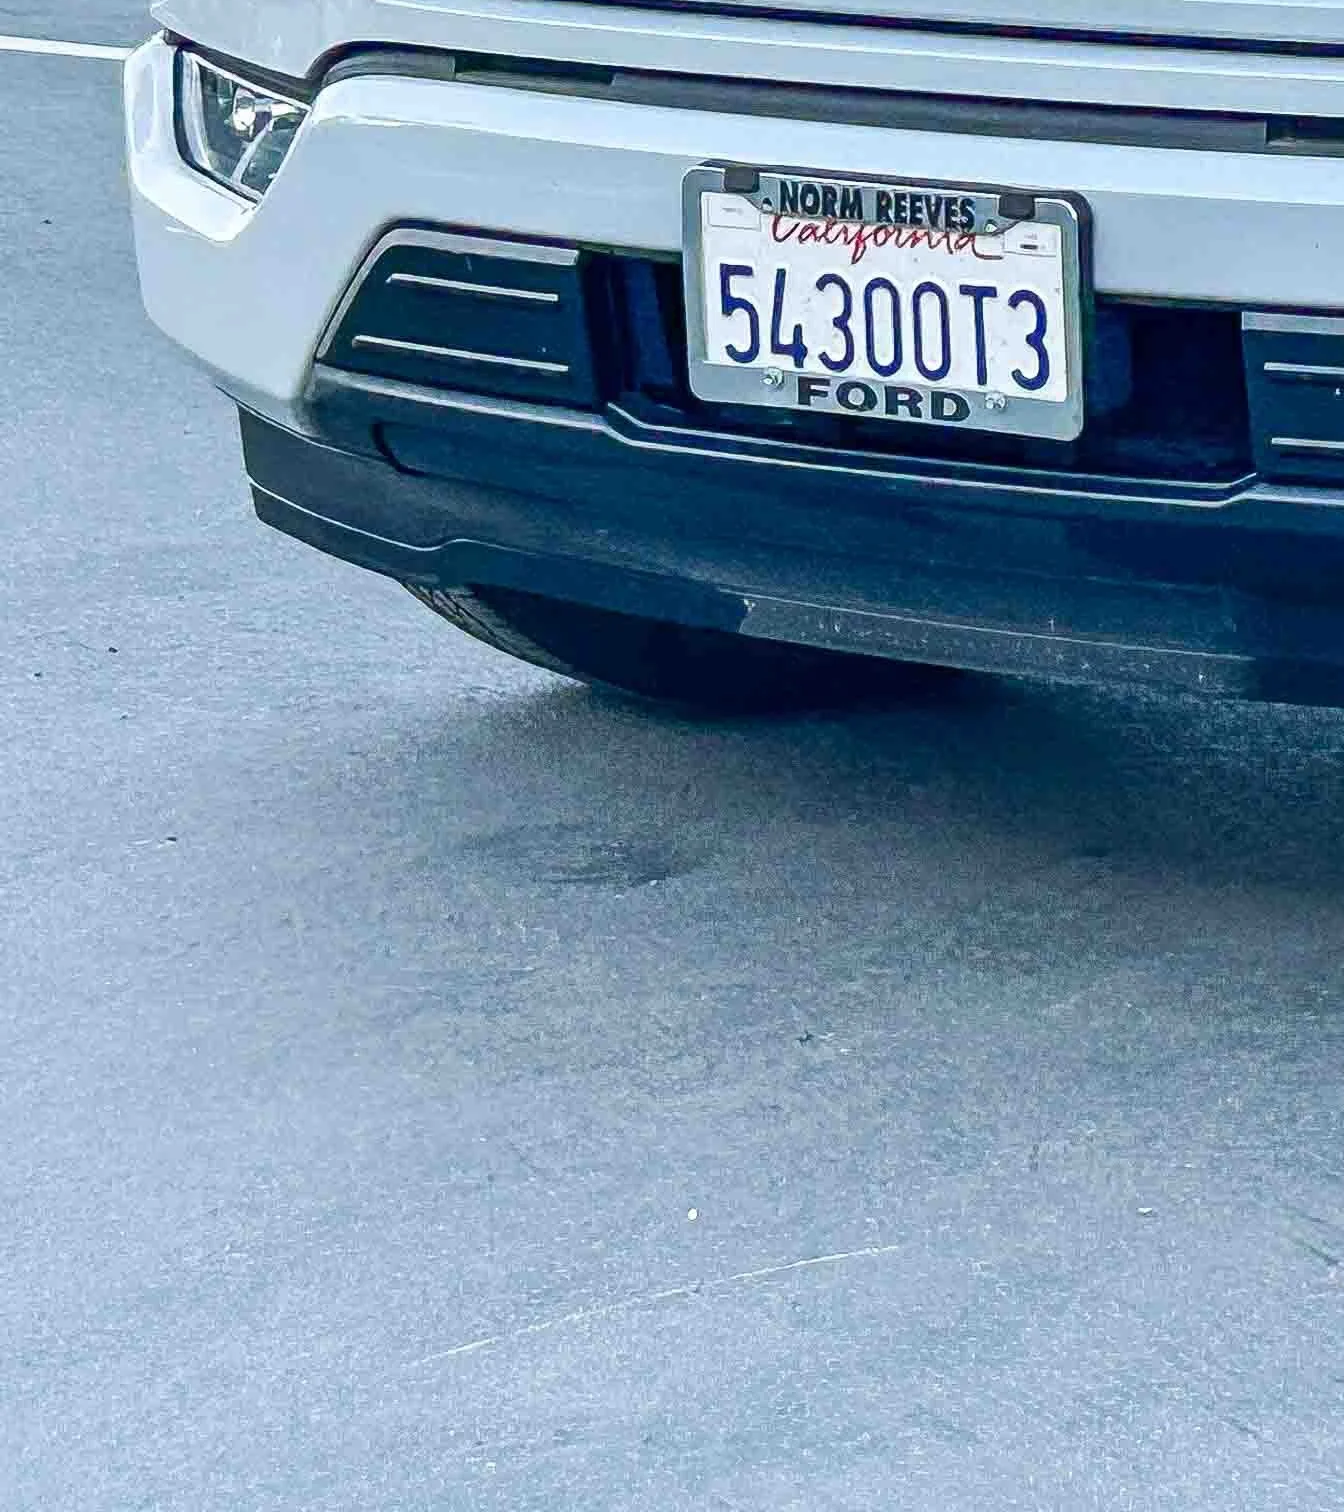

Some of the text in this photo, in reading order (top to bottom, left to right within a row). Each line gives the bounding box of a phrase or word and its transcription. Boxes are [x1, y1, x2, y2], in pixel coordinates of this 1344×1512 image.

[779, 180, 978, 233] NORM REEVES
[718, 262, 1050, 391] 54300T3
[796, 377, 972, 423] FORD
